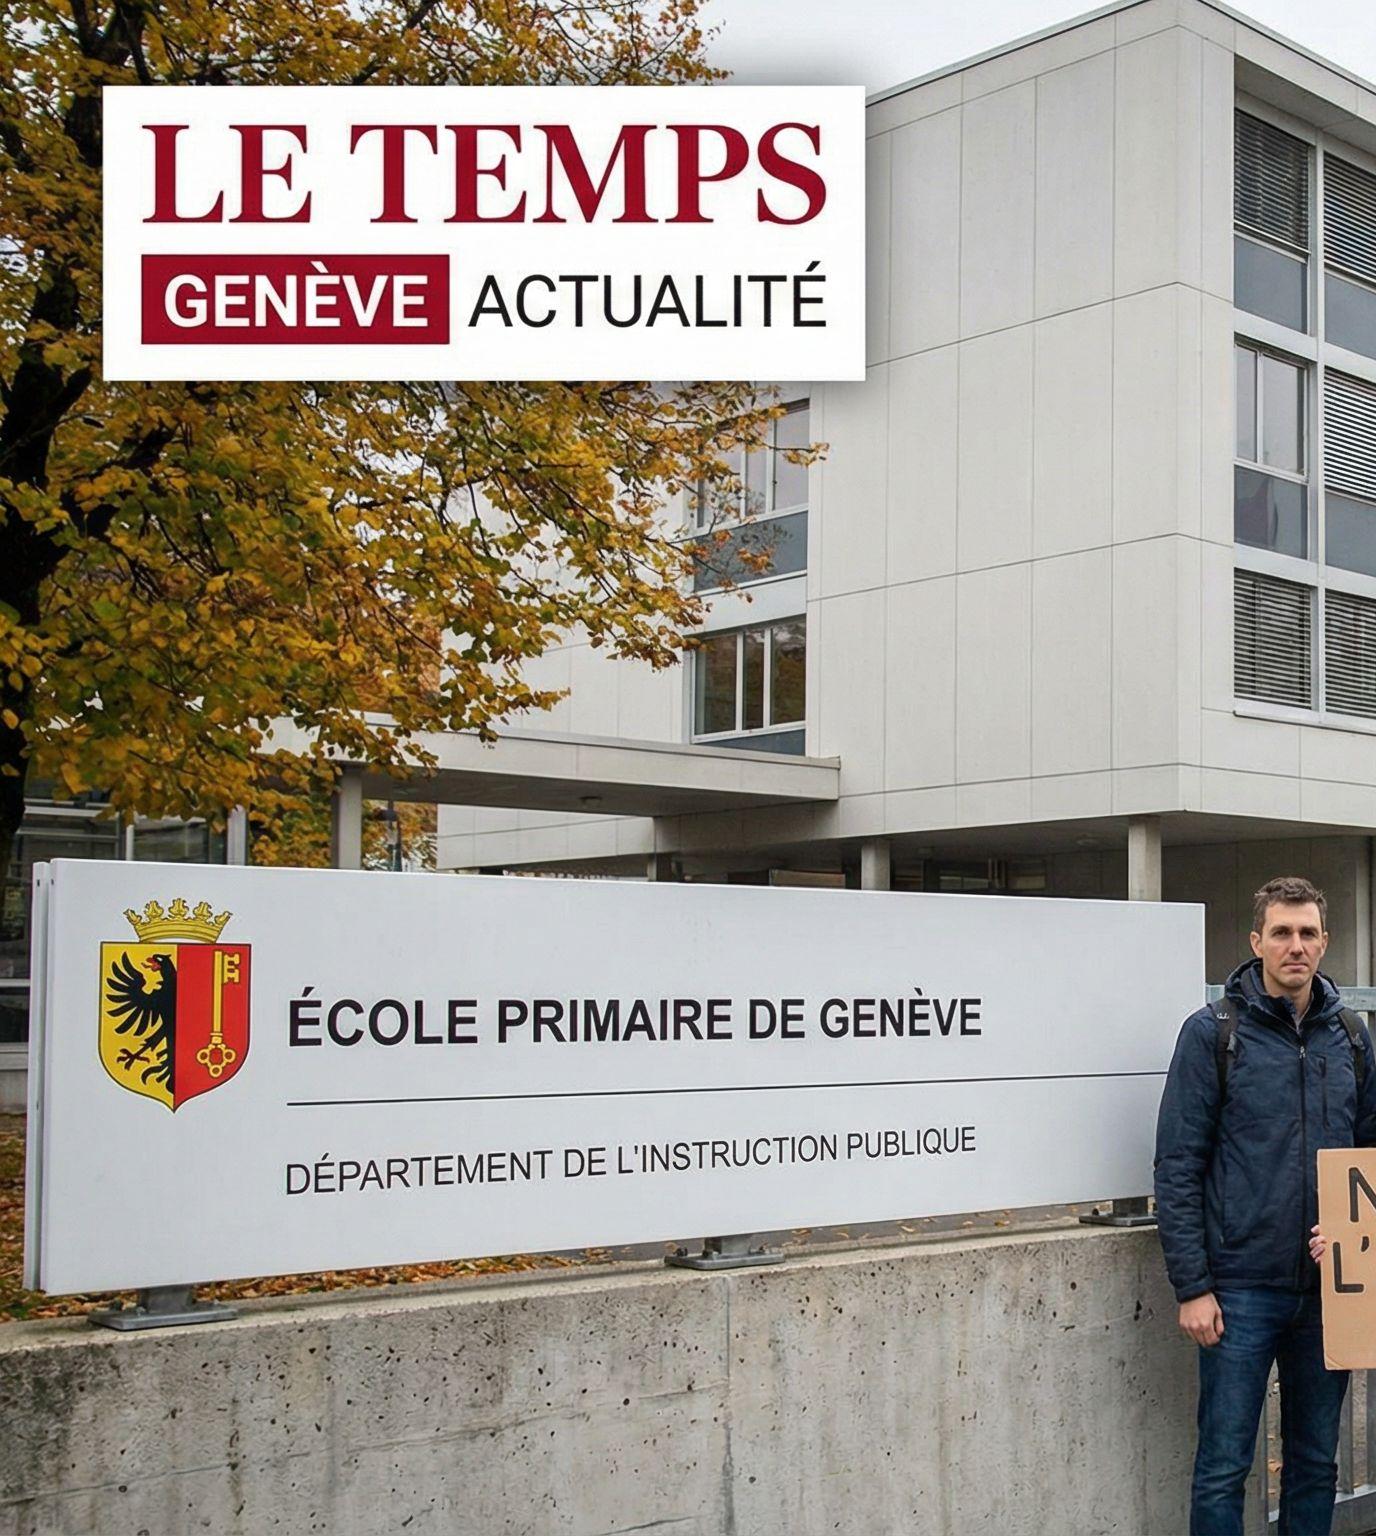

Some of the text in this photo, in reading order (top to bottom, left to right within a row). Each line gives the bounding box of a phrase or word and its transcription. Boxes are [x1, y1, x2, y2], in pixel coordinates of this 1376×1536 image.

[289, 986, 982, 1047] ÉCOLE PRIMAIRE DE GENÈVE
[286, 1126, 976, 1196] DÉPARTEMENT DE L'INSTRUCTION PUBLIQUE
